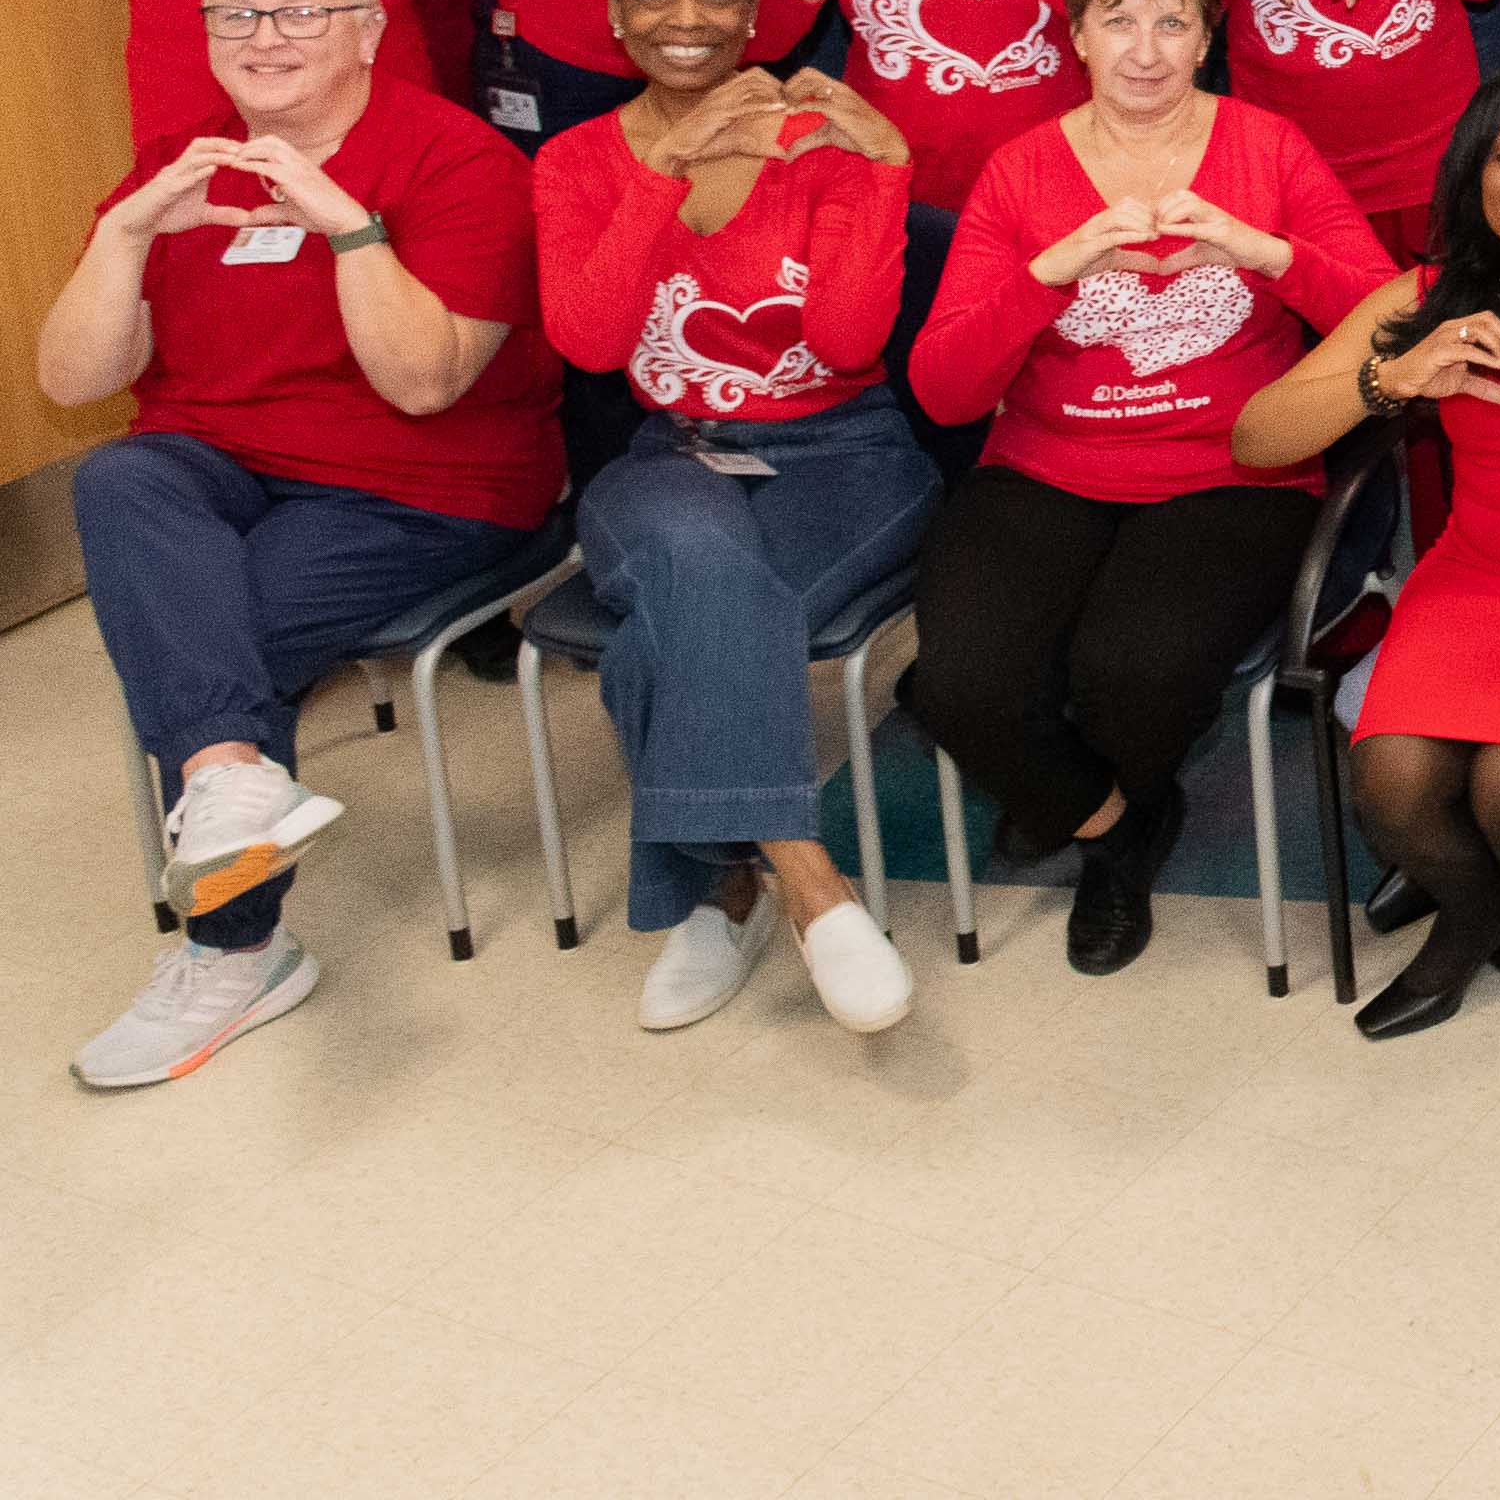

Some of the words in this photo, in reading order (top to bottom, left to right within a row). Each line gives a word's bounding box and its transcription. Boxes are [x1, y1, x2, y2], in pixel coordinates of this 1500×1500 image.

[1113, 380, 1176, 402] Deborah
[1063, 403, 1123, 418] Women's
[1125, 401, 1174, 417] Health
[1175, 394, 1211, 412] Expo
